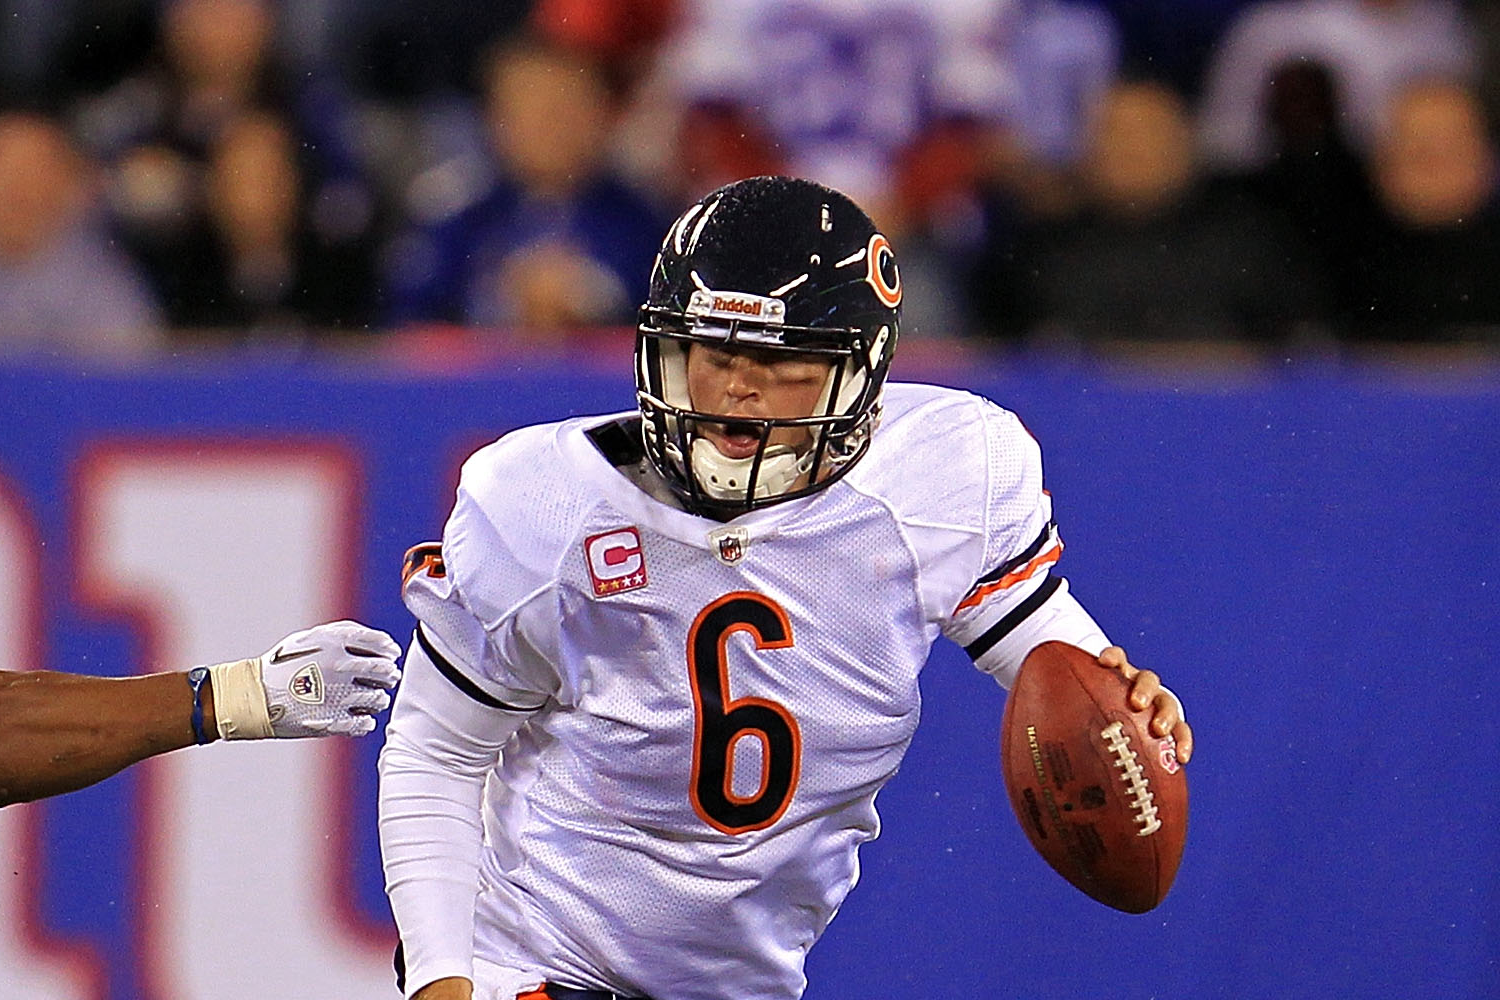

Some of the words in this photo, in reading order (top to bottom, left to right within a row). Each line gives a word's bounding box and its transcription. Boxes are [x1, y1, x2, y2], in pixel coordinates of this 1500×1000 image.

[713, 296, 762, 316] Riddell
[589, 531, 642, 580] C
[686, 590, 801, 836] 6
